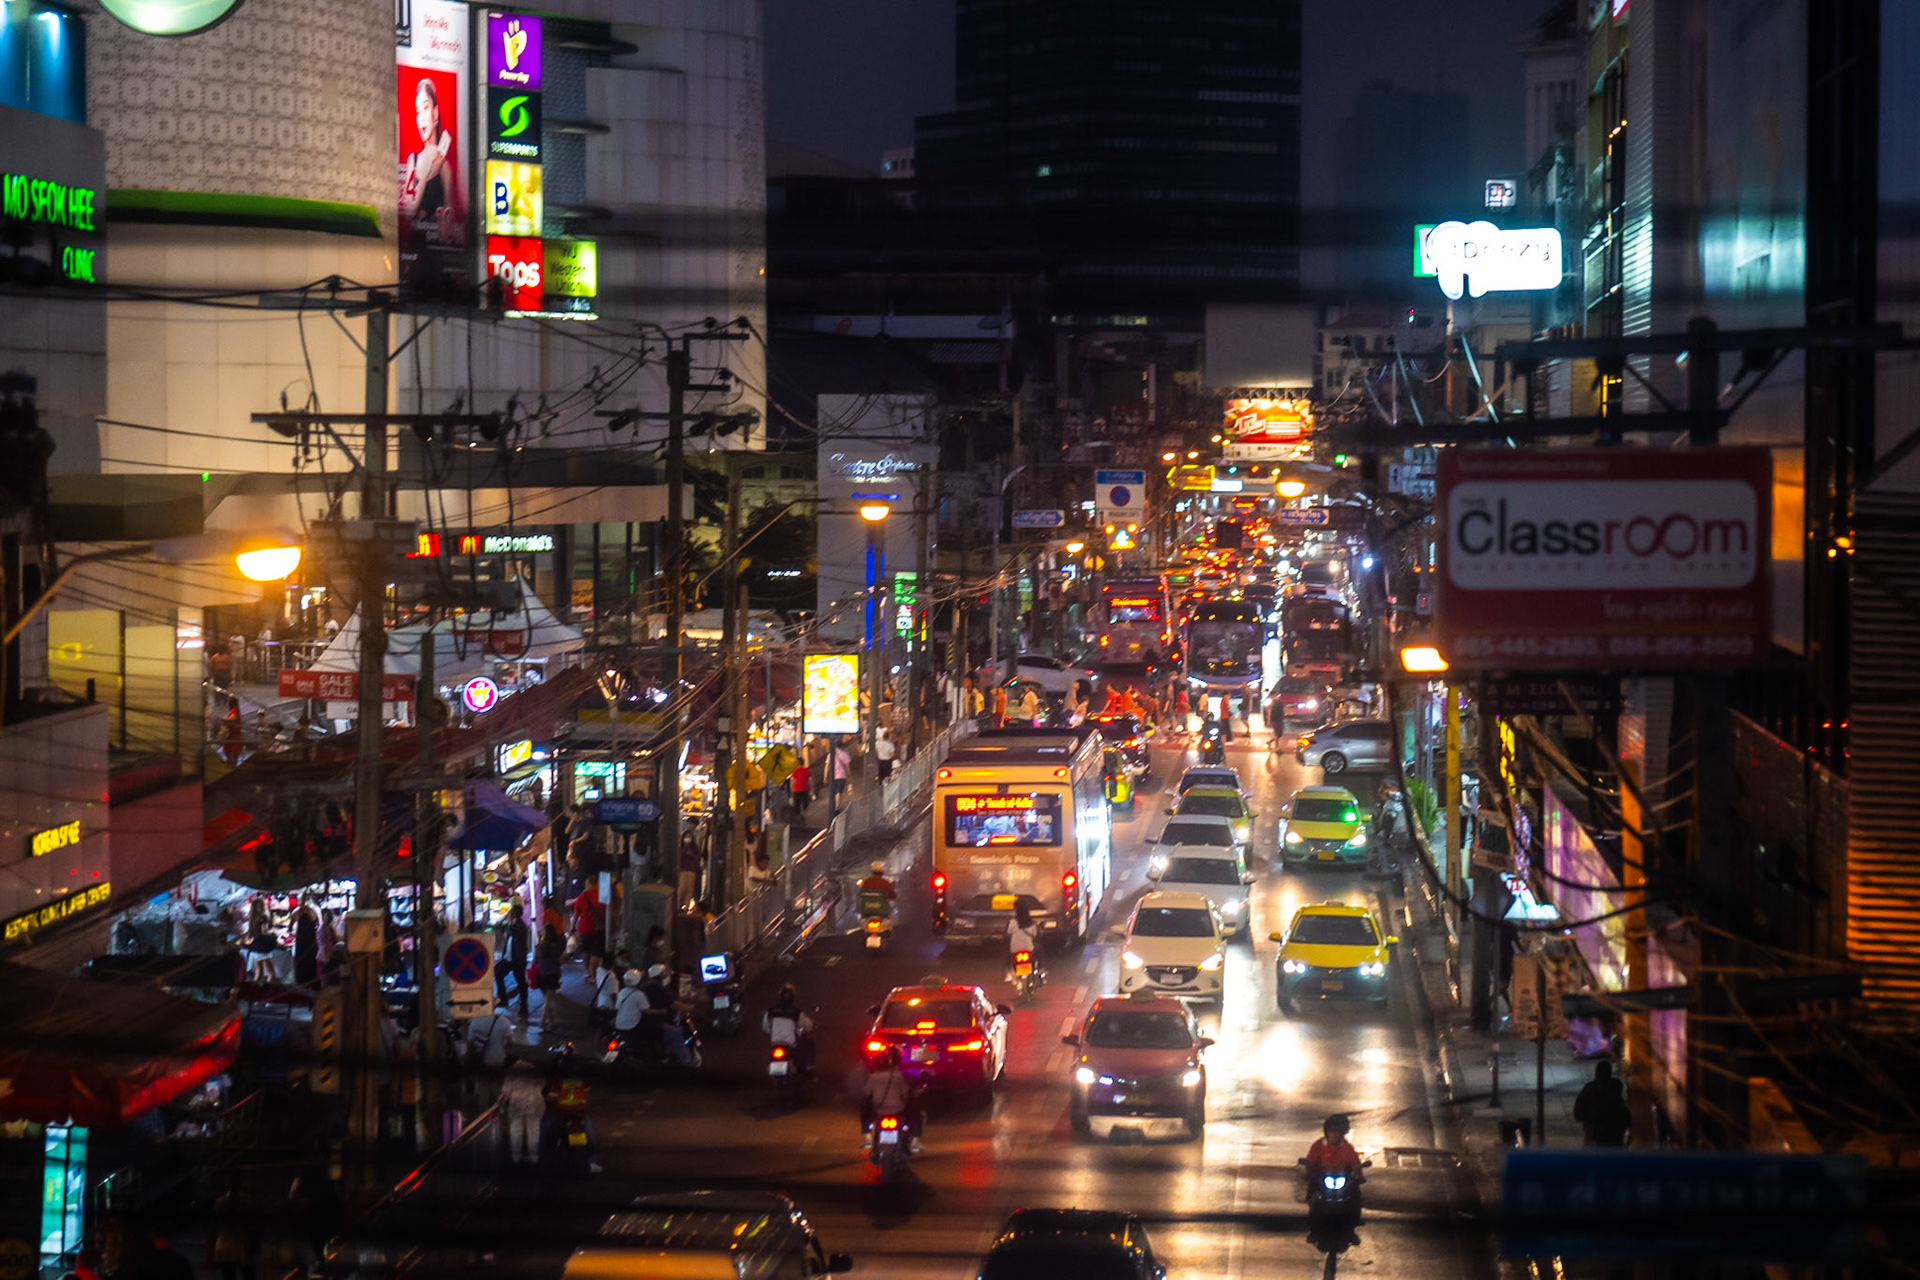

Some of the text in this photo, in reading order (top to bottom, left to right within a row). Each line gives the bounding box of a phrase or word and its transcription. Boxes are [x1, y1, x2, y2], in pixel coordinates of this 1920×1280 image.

[3, 173, 29, 219] MO
[68, 187, 95, 231] HEE
[62, 246, 96, 283] CLINIC
[489, 254, 540, 294] Tops
[484, 534, 553, 553] McDonald's
[1457, 497, 1749, 559] Classroom
[319, 675, 353, 687] SALE
[319, 687, 353, 697] SALE
